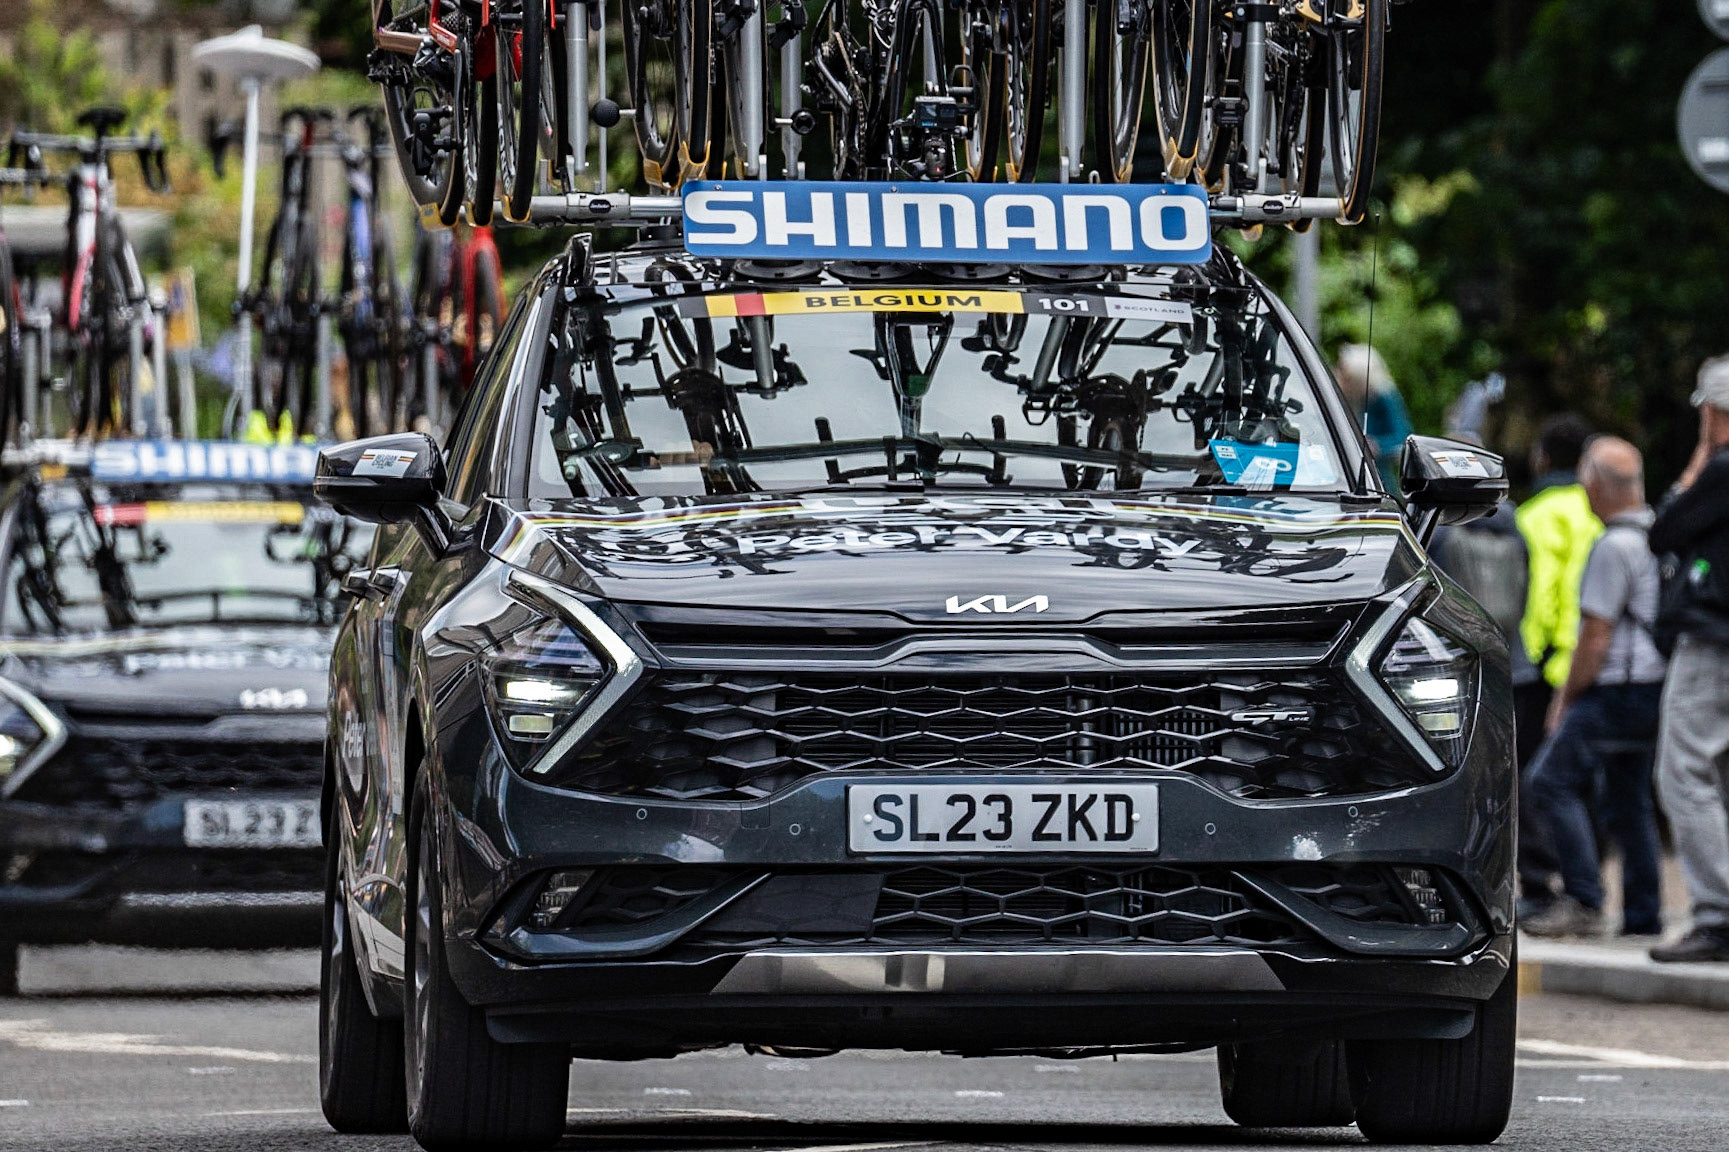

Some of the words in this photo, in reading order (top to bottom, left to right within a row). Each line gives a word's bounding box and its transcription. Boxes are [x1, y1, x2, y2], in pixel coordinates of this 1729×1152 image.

[685, 190, 1208, 252] SHIMANO
[806, 295, 982, 310] BELGIUM
[1038, 298, 1090, 312] 101
[1124, 306, 1186, 315] SCOTLAND
[736, 524, 952, 554] Peter
[971, 526, 1202, 556] Vardy
[945, 595, 1049, 614] KIA
[873, 793, 1013, 842] SL23
[1031, 793, 1134, 842] ZKD
